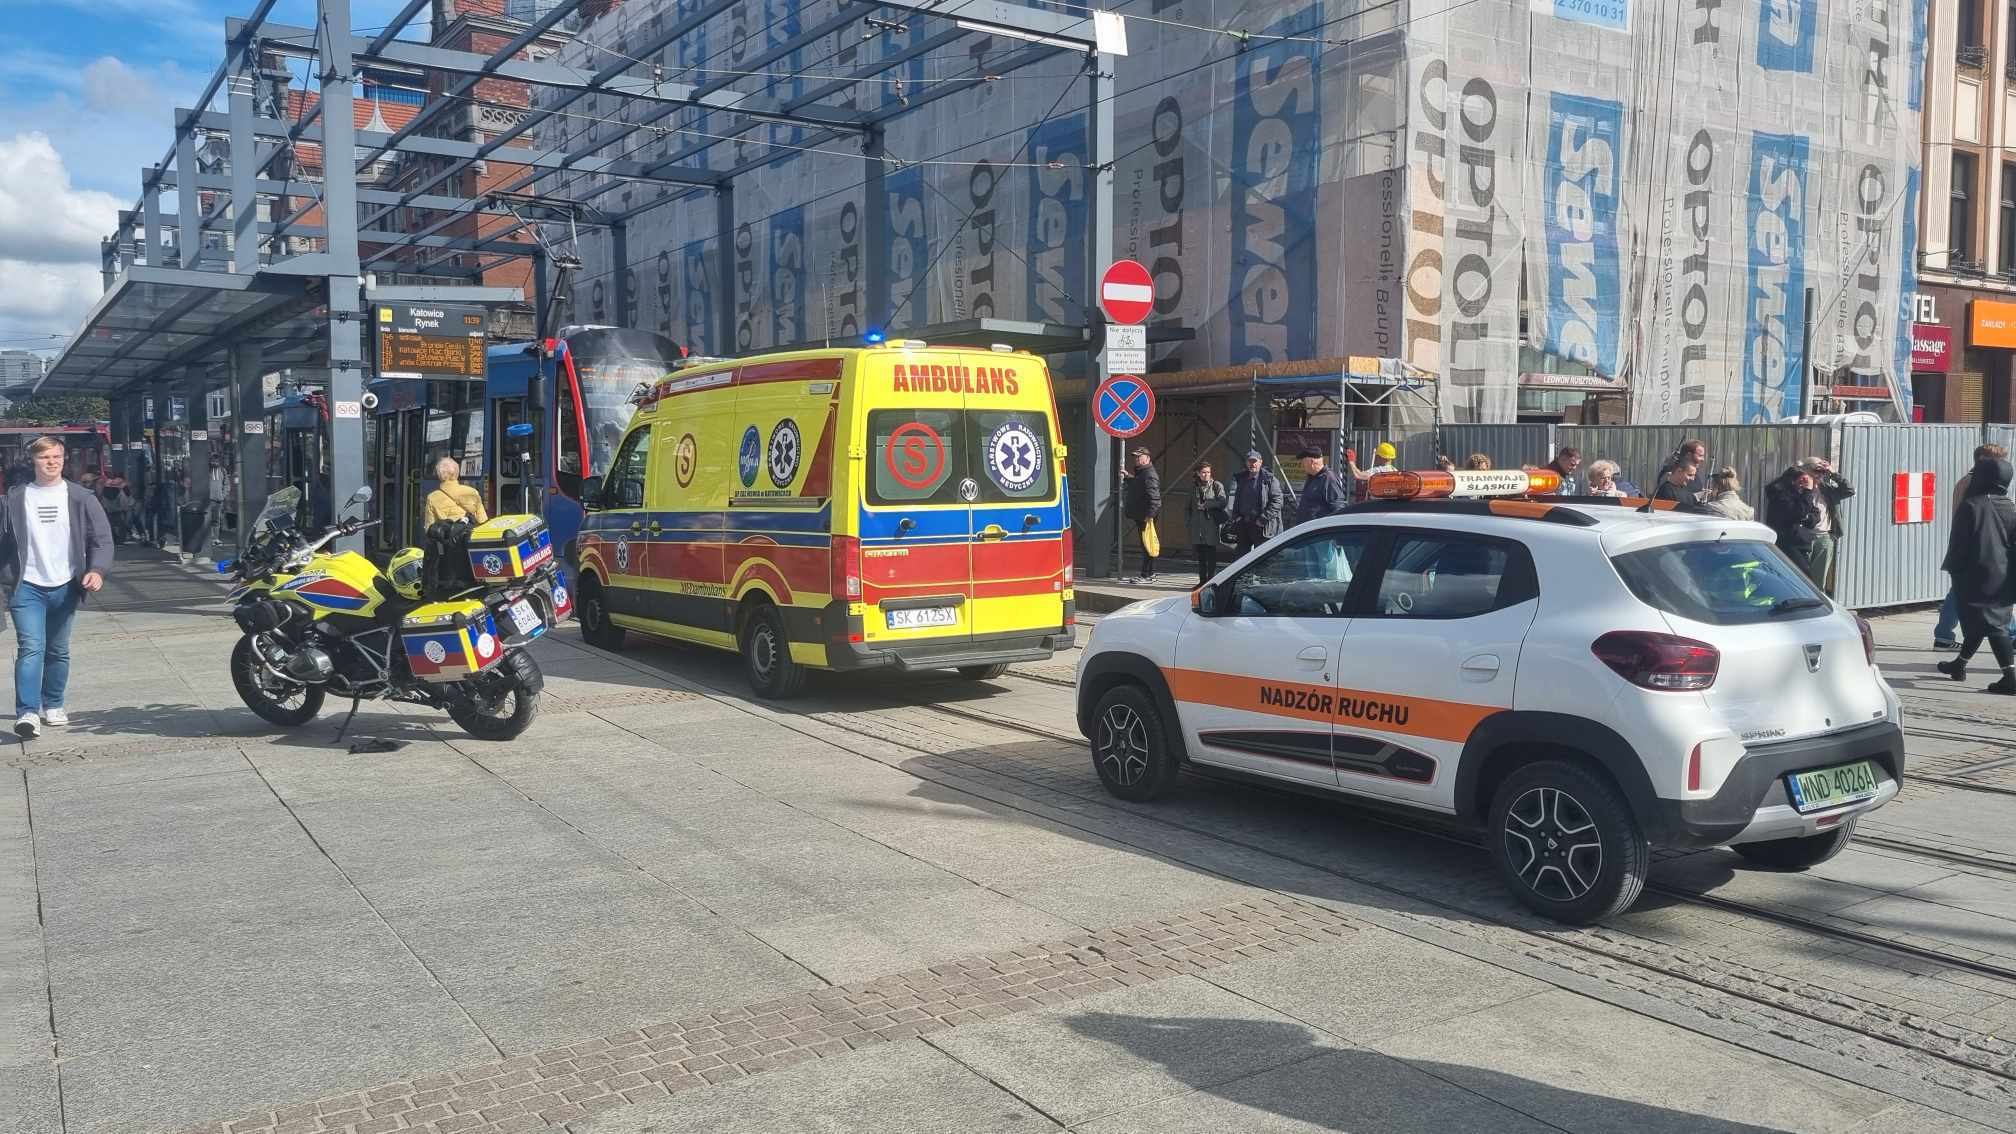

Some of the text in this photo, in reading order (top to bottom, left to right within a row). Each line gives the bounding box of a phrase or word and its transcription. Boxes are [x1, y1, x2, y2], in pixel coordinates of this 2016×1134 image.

[1594, 4, 1608, 17] 10
[1611, 8, 1624, 22] 31
[410, 307, 445, 318] Katowice
[415, 318, 440, 329] Rynek
[1911, 336, 1947, 357] assage
[893, 364, 1019, 396] AMBULANS
[903, 436, 928, 476] S
[999, 476, 1035, 491] MEDYCZNE
[1458, 474, 1526, 482] TRAMWAJE
[1466, 482, 1519, 491] ŚLĄSKIE
[896, 612, 913, 625] SK
[1260, 686, 1409, 726] NADZÓR RUCHU
[1799, 764, 1876, 802] WND 4026A
